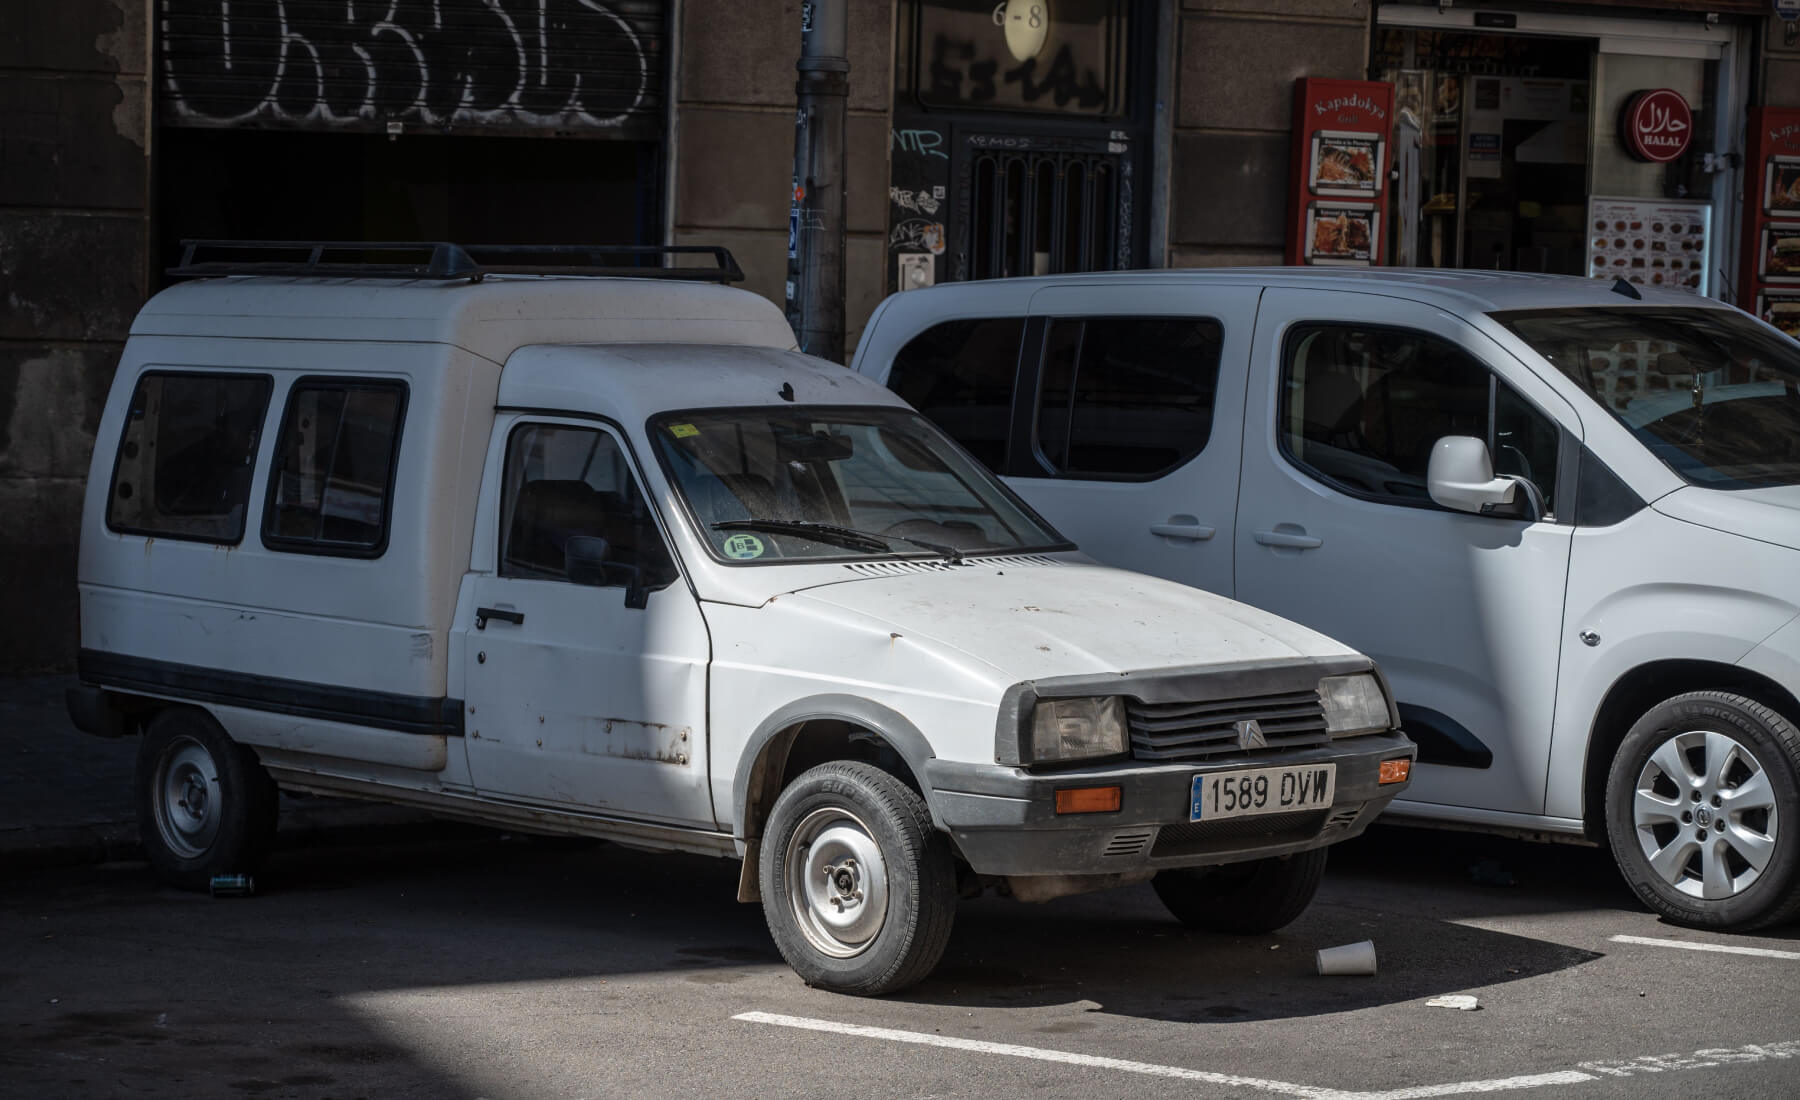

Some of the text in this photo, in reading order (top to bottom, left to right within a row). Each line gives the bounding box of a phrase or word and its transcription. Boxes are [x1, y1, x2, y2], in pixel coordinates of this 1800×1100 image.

[1314, 93, 1385, 120] Kapadokya
[1639, 101, 1687, 133] حلال
[1643, 135, 1682, 147] HALAL
[1212, 775, 1269, 812] 1589
[1194, 802, 1201, 813] E
